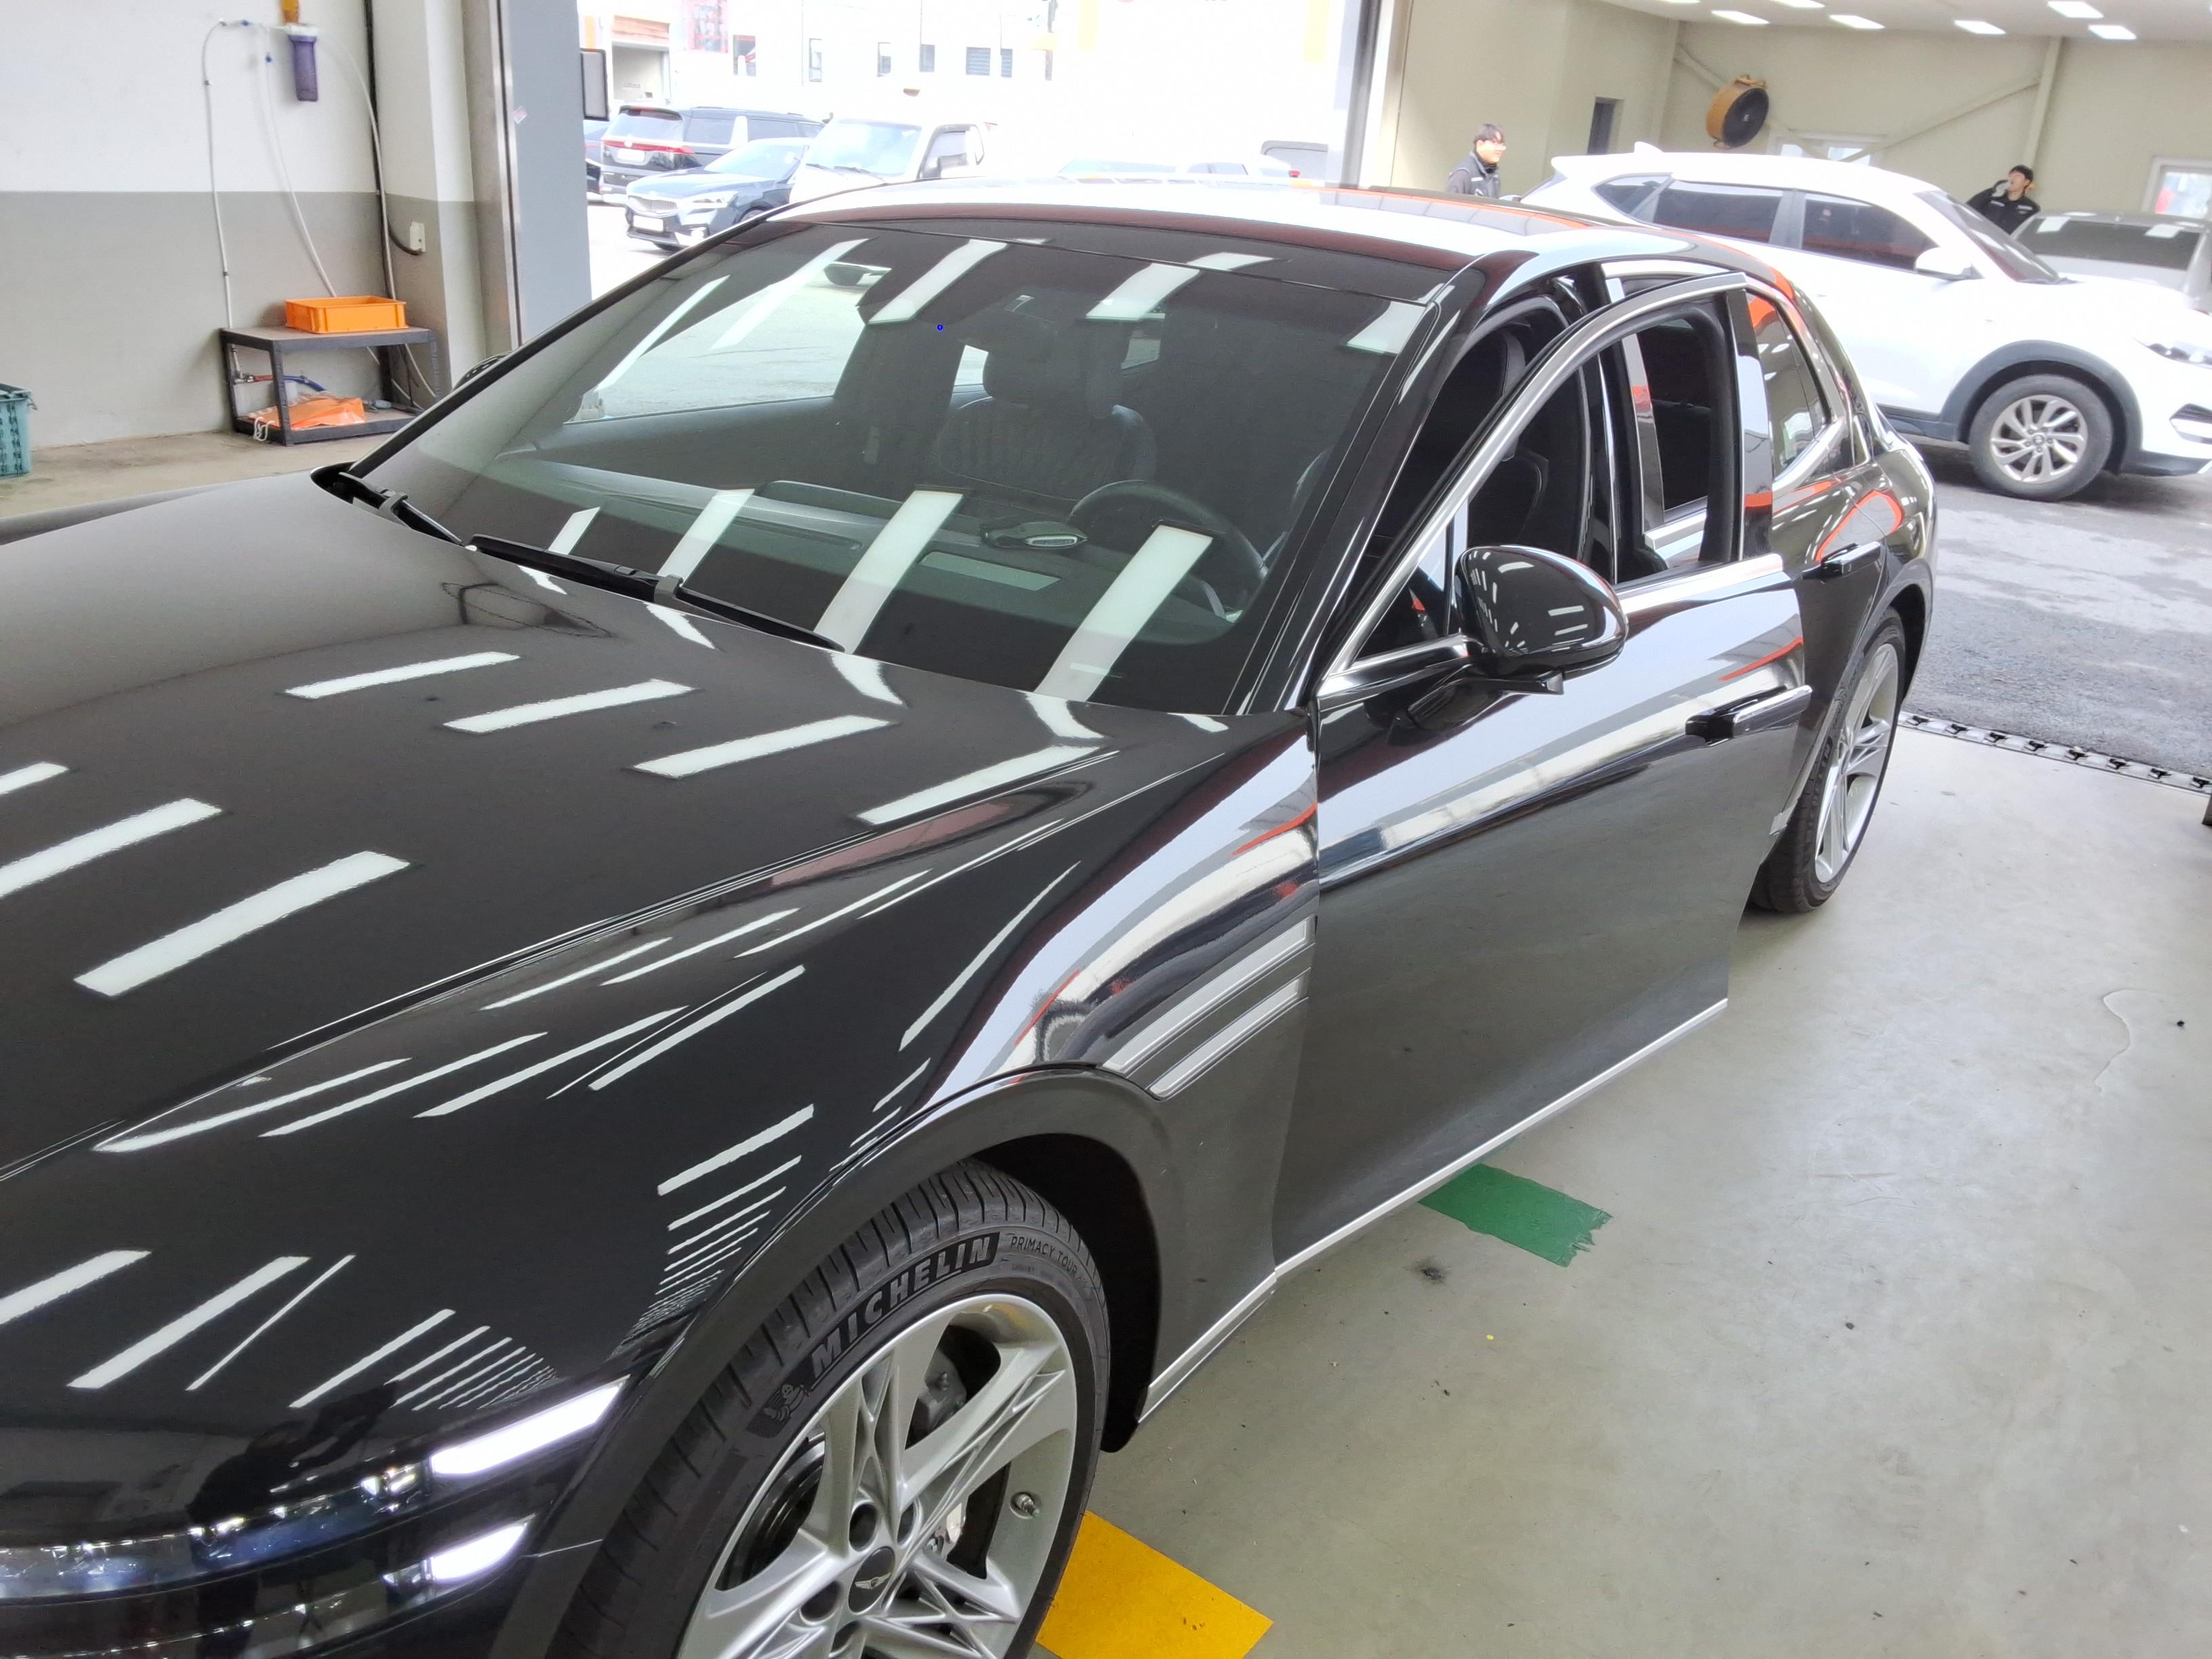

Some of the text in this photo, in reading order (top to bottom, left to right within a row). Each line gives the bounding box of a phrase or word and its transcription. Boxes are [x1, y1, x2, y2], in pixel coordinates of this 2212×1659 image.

[1010, 1236, 1055, 1257] PRIMACY
[1057, 1250, 1078, 1278] TOUR
[812, 1236, 990, 1378] MICHELIN
